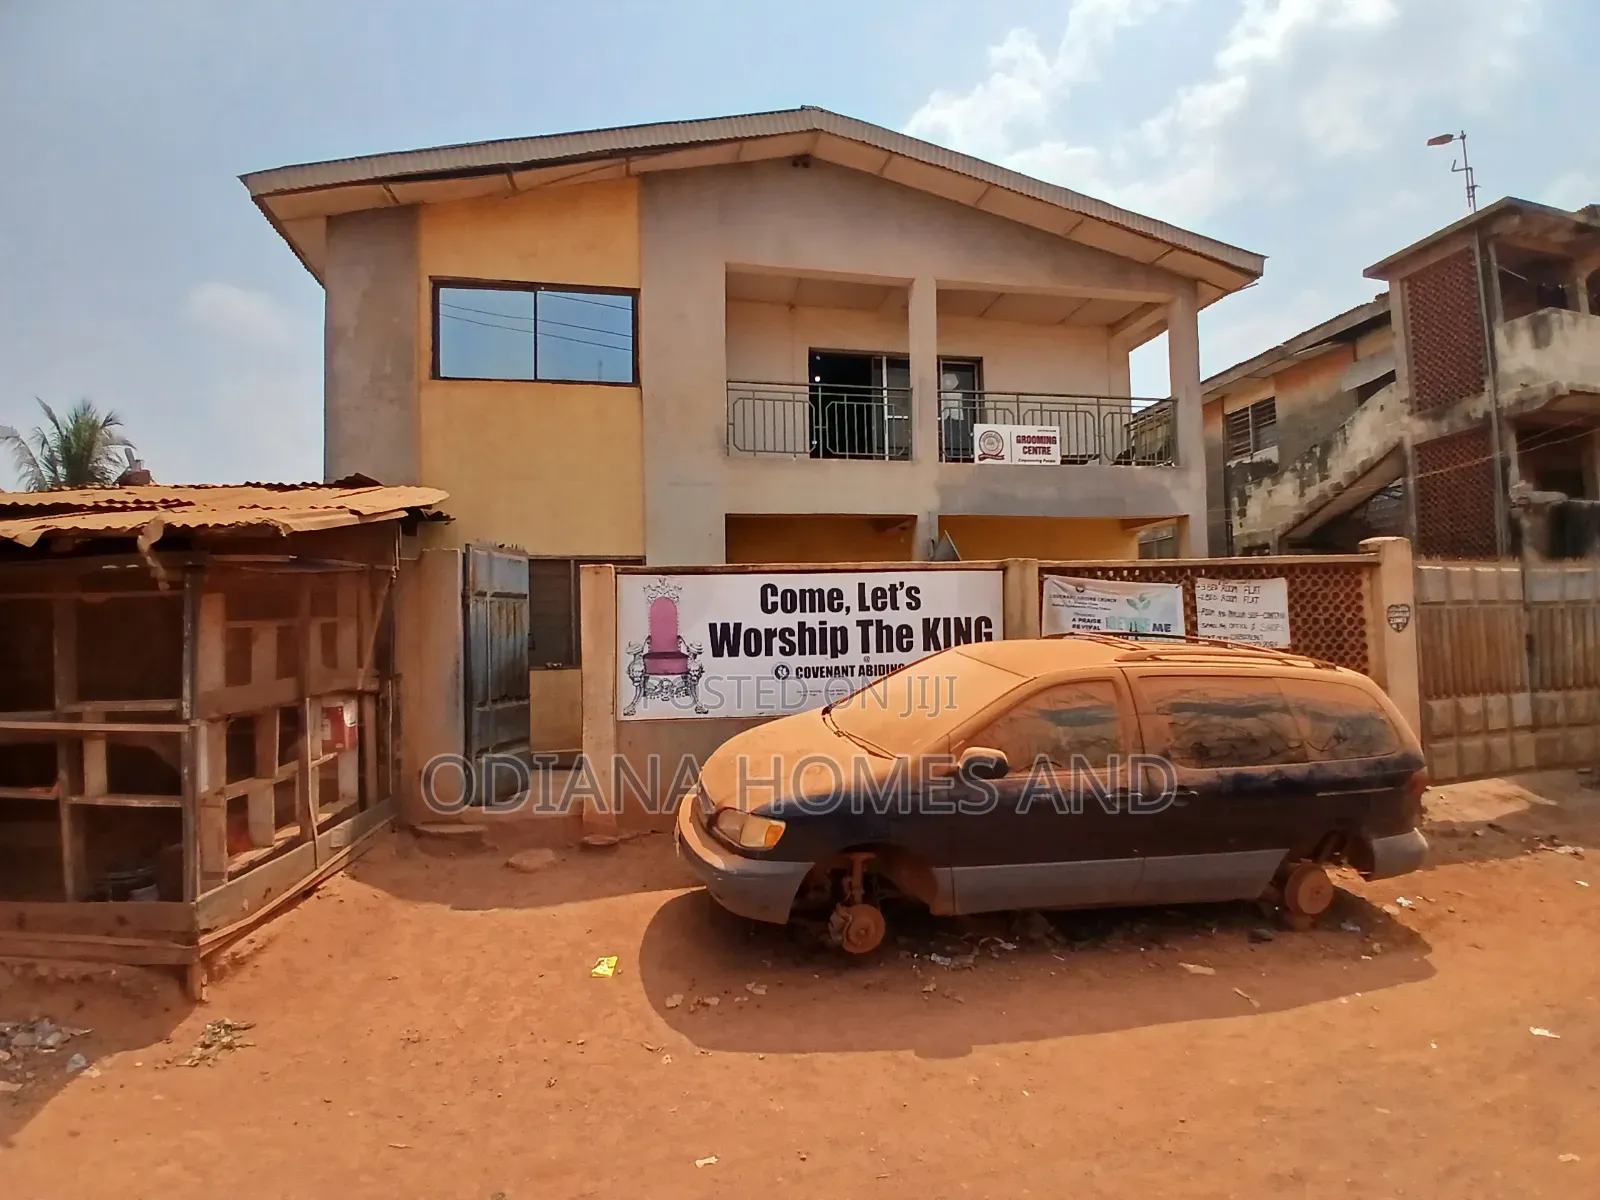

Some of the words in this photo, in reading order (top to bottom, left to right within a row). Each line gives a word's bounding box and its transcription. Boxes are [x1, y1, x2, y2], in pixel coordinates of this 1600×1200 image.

[1016, 435, 1057, 445] GROOMING
[1022, 446, 1052, 455] CENTRE
[1244, 585, 1261, 595] FLAT
[760, 582, 850, 616] Come,
[857, 581, 921, 612] Let's
[1243, 595, 1260, 604] FLAT
[1152, 622, 1172, 632] ME
[708, 621, 848, 659] Worship
[855, 619, 914, 654] The
[923, 615, 993, 652] KING
[795, 665, 856, 679] COVENANT
